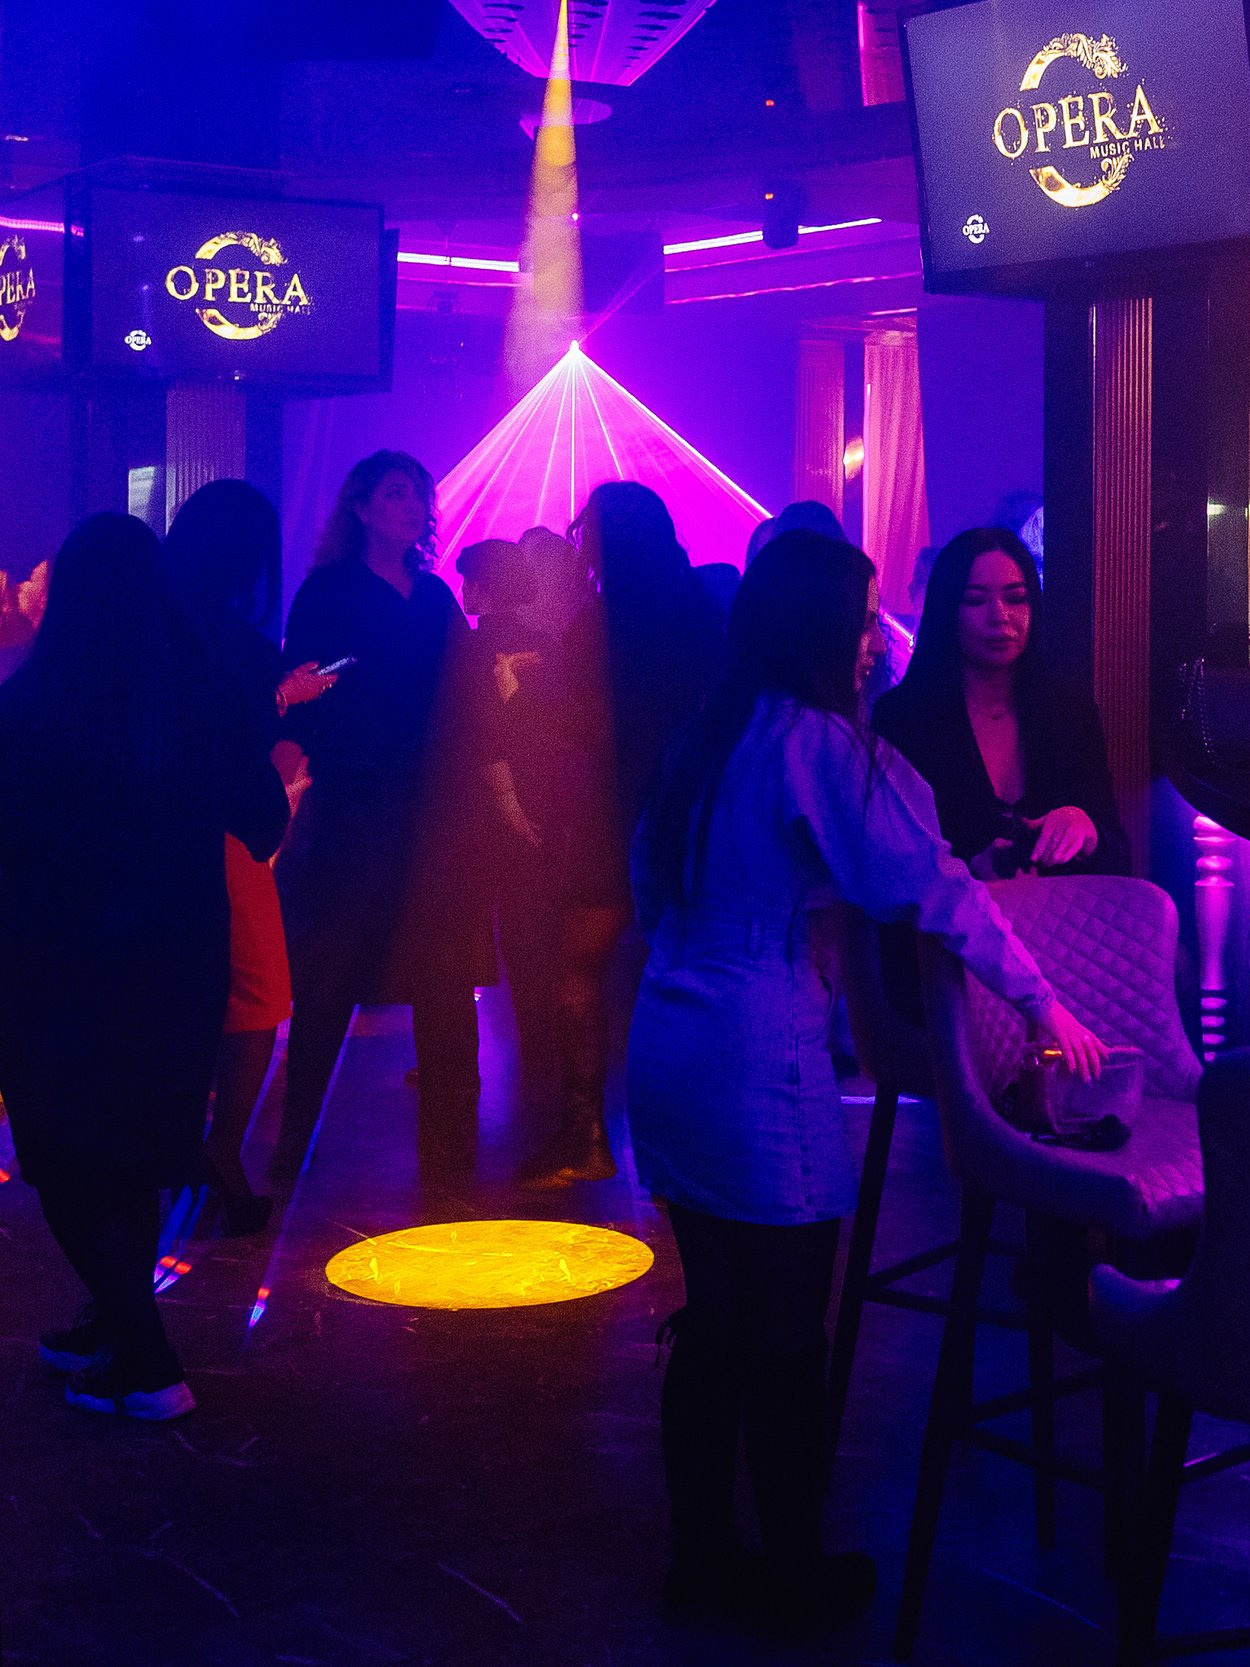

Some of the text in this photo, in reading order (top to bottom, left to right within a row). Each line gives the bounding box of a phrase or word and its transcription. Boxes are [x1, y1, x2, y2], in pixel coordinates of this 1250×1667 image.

[993, 84, 1164, 159] OPERA
[1089, 135, 1165, 159] MUSIC HALL
[0, 267, 36, 306] PERA
[165, 266, 310, 305] OPERA
